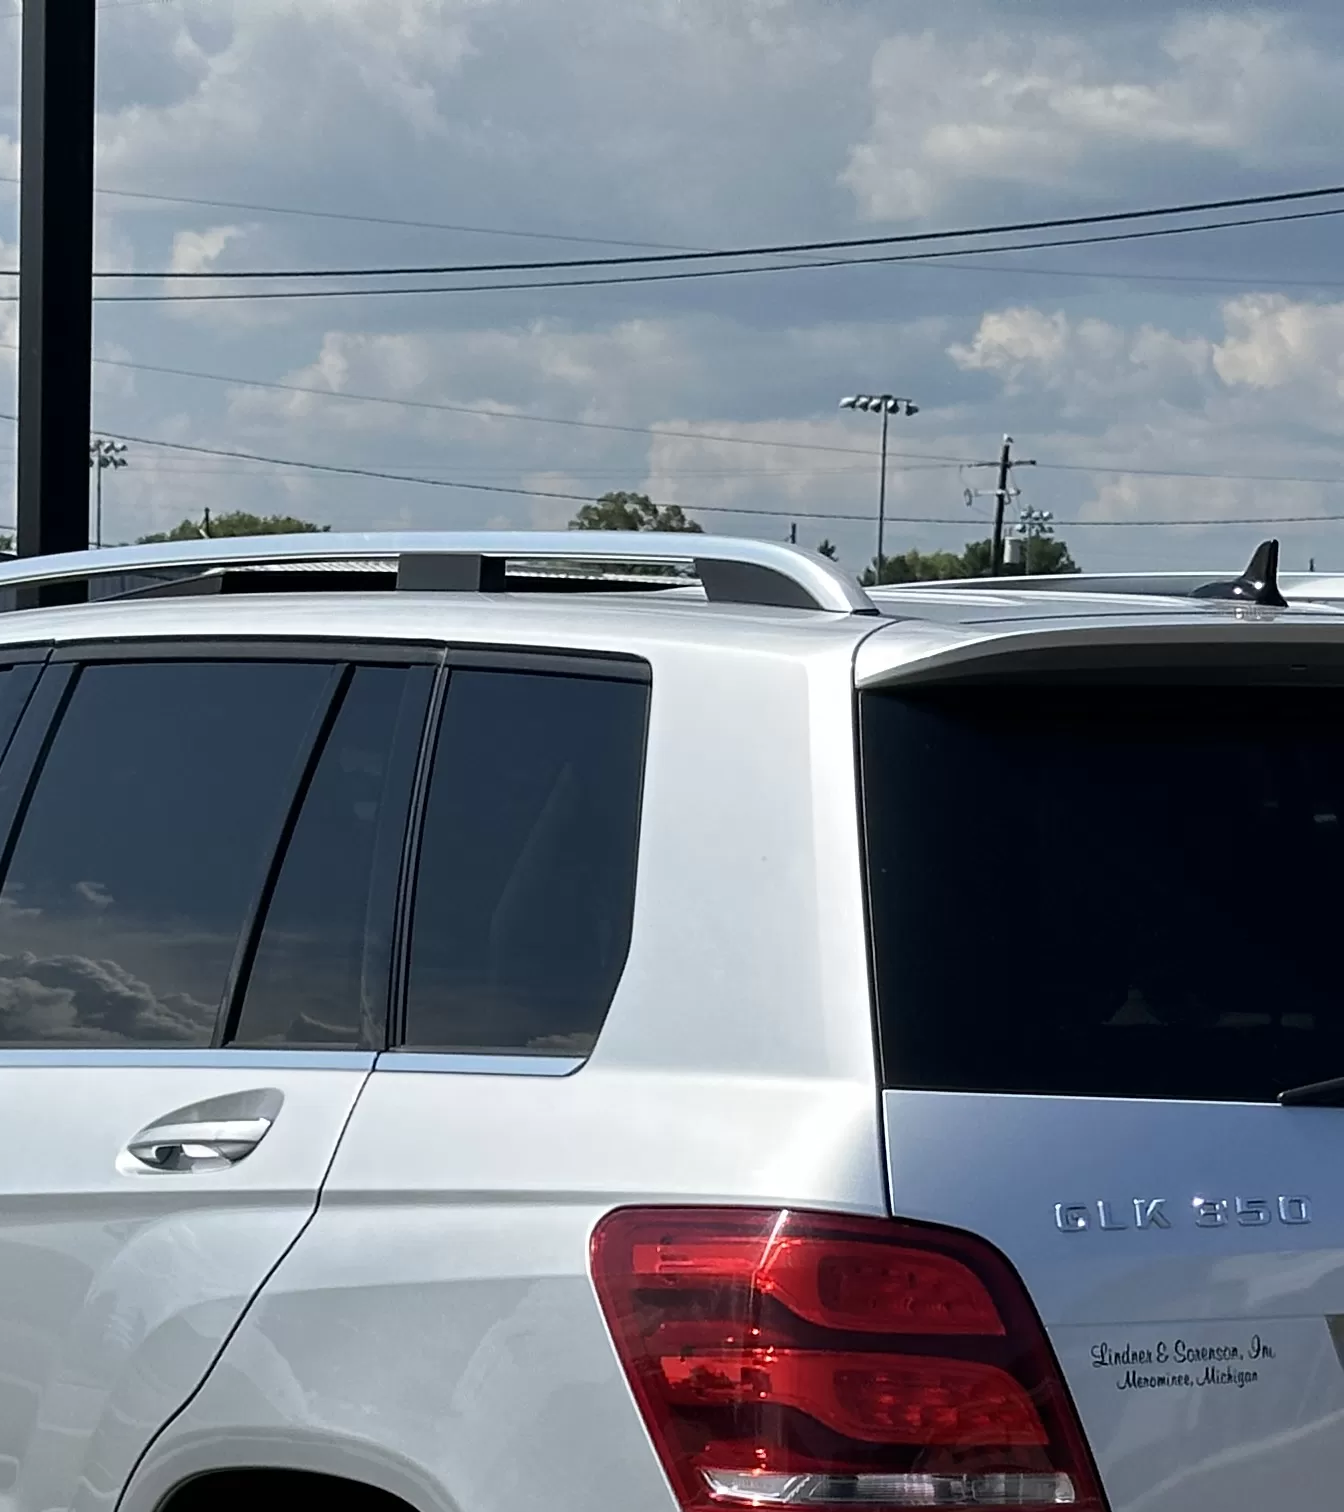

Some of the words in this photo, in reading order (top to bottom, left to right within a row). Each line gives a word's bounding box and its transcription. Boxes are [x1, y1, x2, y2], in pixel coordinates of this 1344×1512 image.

[1054, 1197, 1172, 1233] GLK
[1192, 1192, 1312, 1229] 350
[1090, 1342, 1152, 1368] Lindner
[1156, 1341, 1169, 1363] &
[1172, 1339, 1244, 1362] Sorenson,
[1196, 1366, 1259, 1388] Michigan
